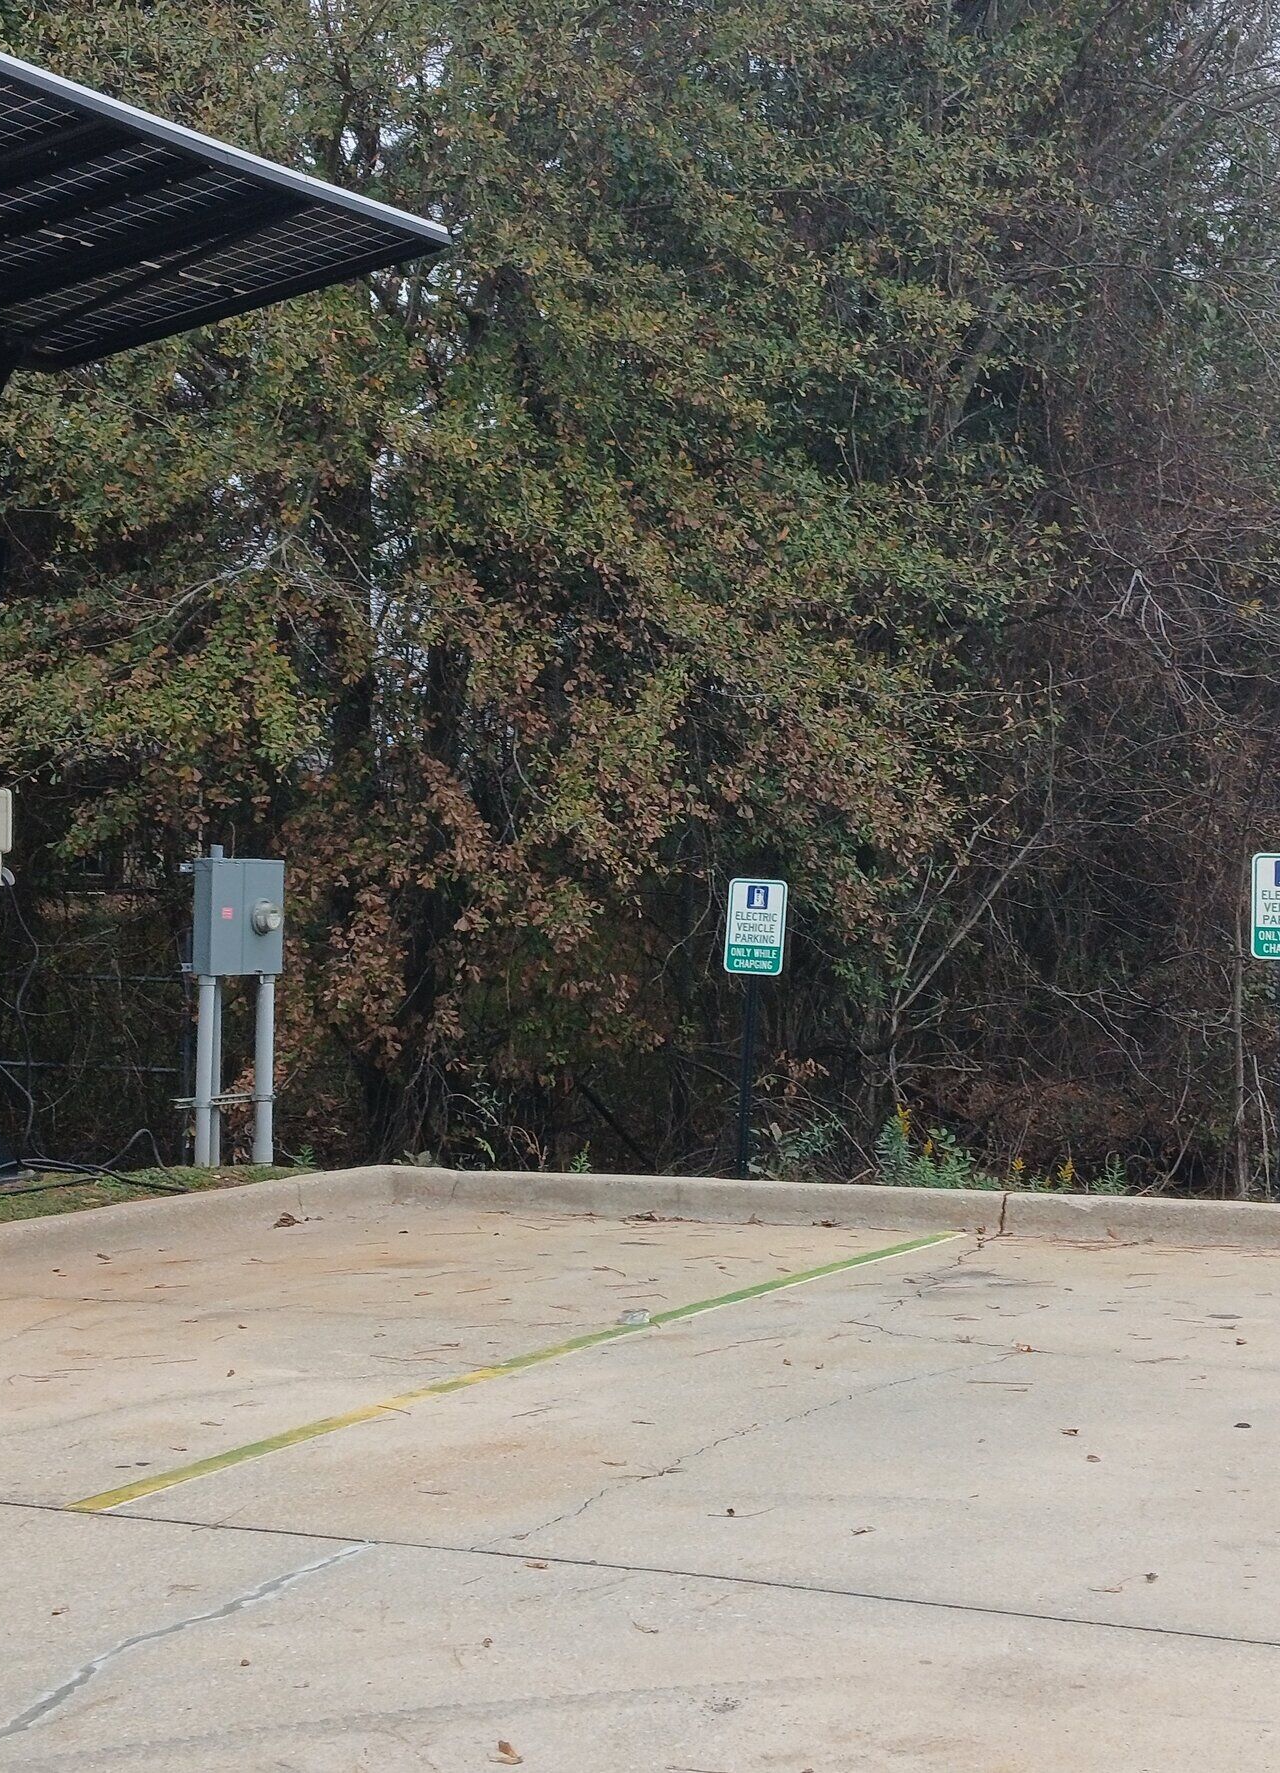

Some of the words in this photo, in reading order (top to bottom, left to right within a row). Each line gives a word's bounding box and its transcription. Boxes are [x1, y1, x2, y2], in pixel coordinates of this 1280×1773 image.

[735, 911, 778, 922] ELECTRIC
[737, 922, 775, 933] VEHICLE
[735, 933, 775, 944] PARKING
[730, 947, 753, 957] ONLY
[753, 948, 778, 959] WHILE
[733, 959, 773, 970] CHARGING
